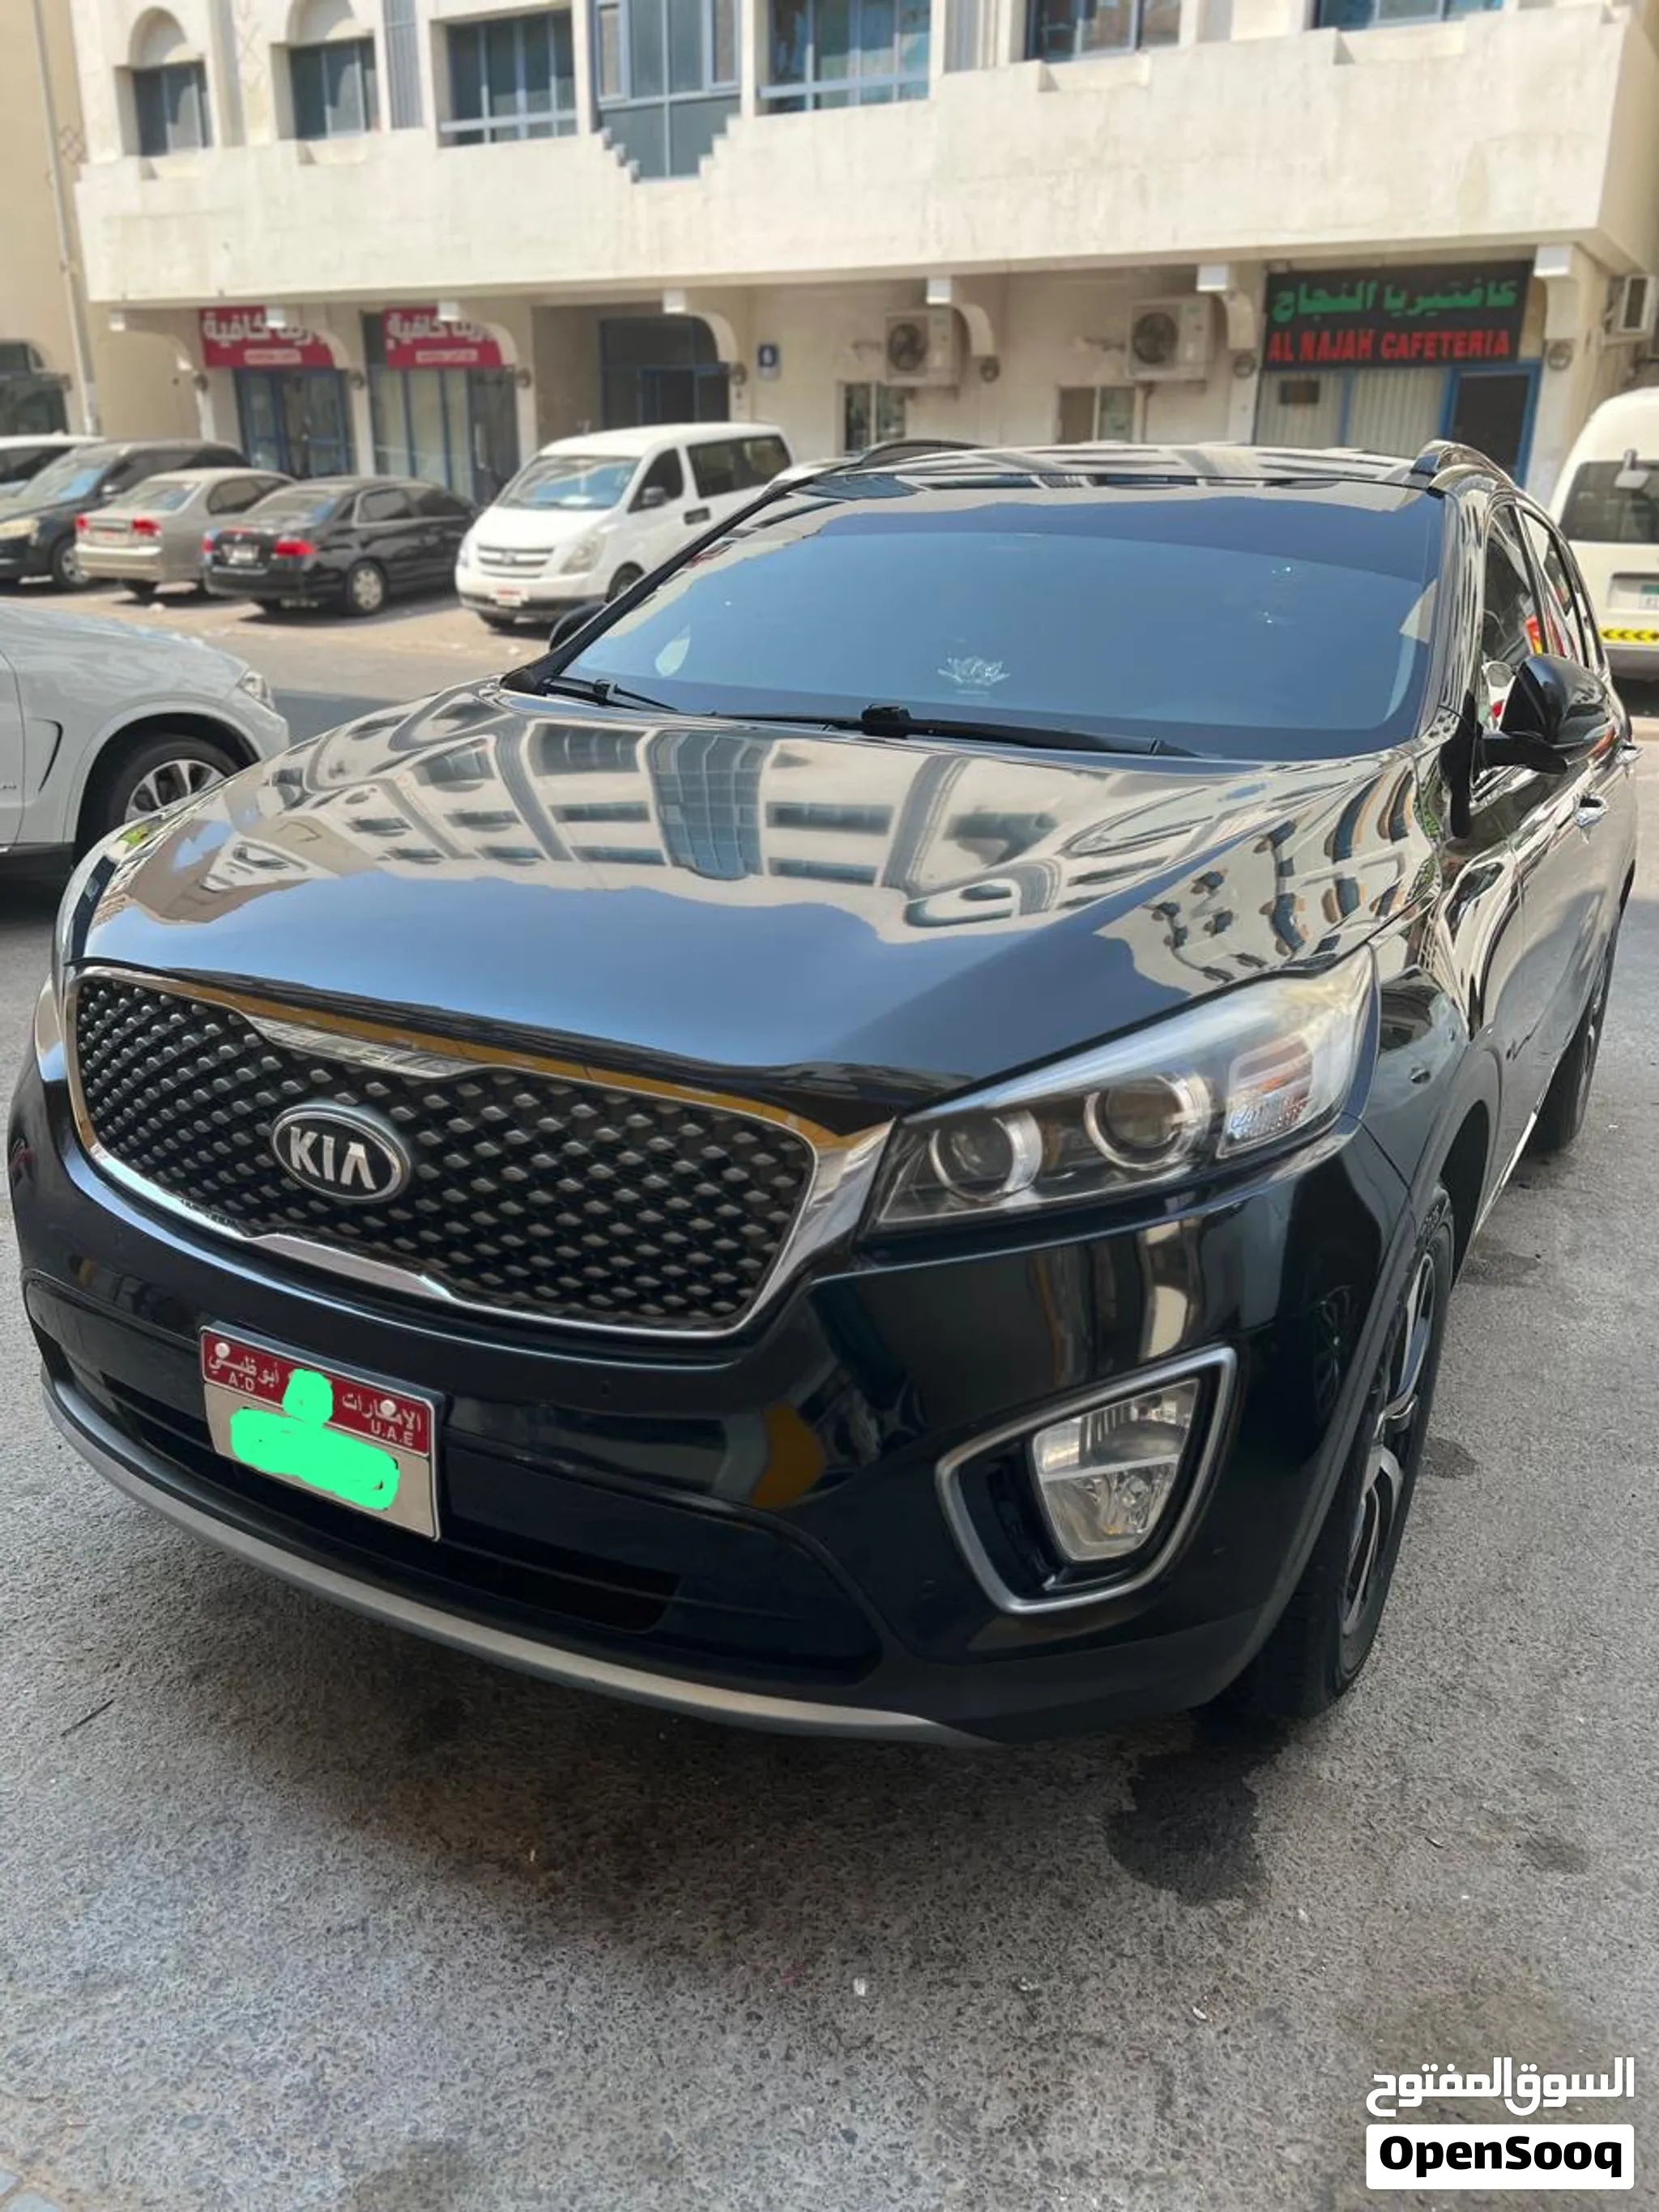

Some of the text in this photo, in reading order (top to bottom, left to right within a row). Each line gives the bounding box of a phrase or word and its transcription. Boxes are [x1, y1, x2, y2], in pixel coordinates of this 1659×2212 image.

[1273, 279, 1378, 322] النجاح
[1267, 328, 1510, 361] AL NAJAH CAFETERIA
[290, 1126, 377, 1190] KIA
[371, 1419, 414, 1447] U.A.E
